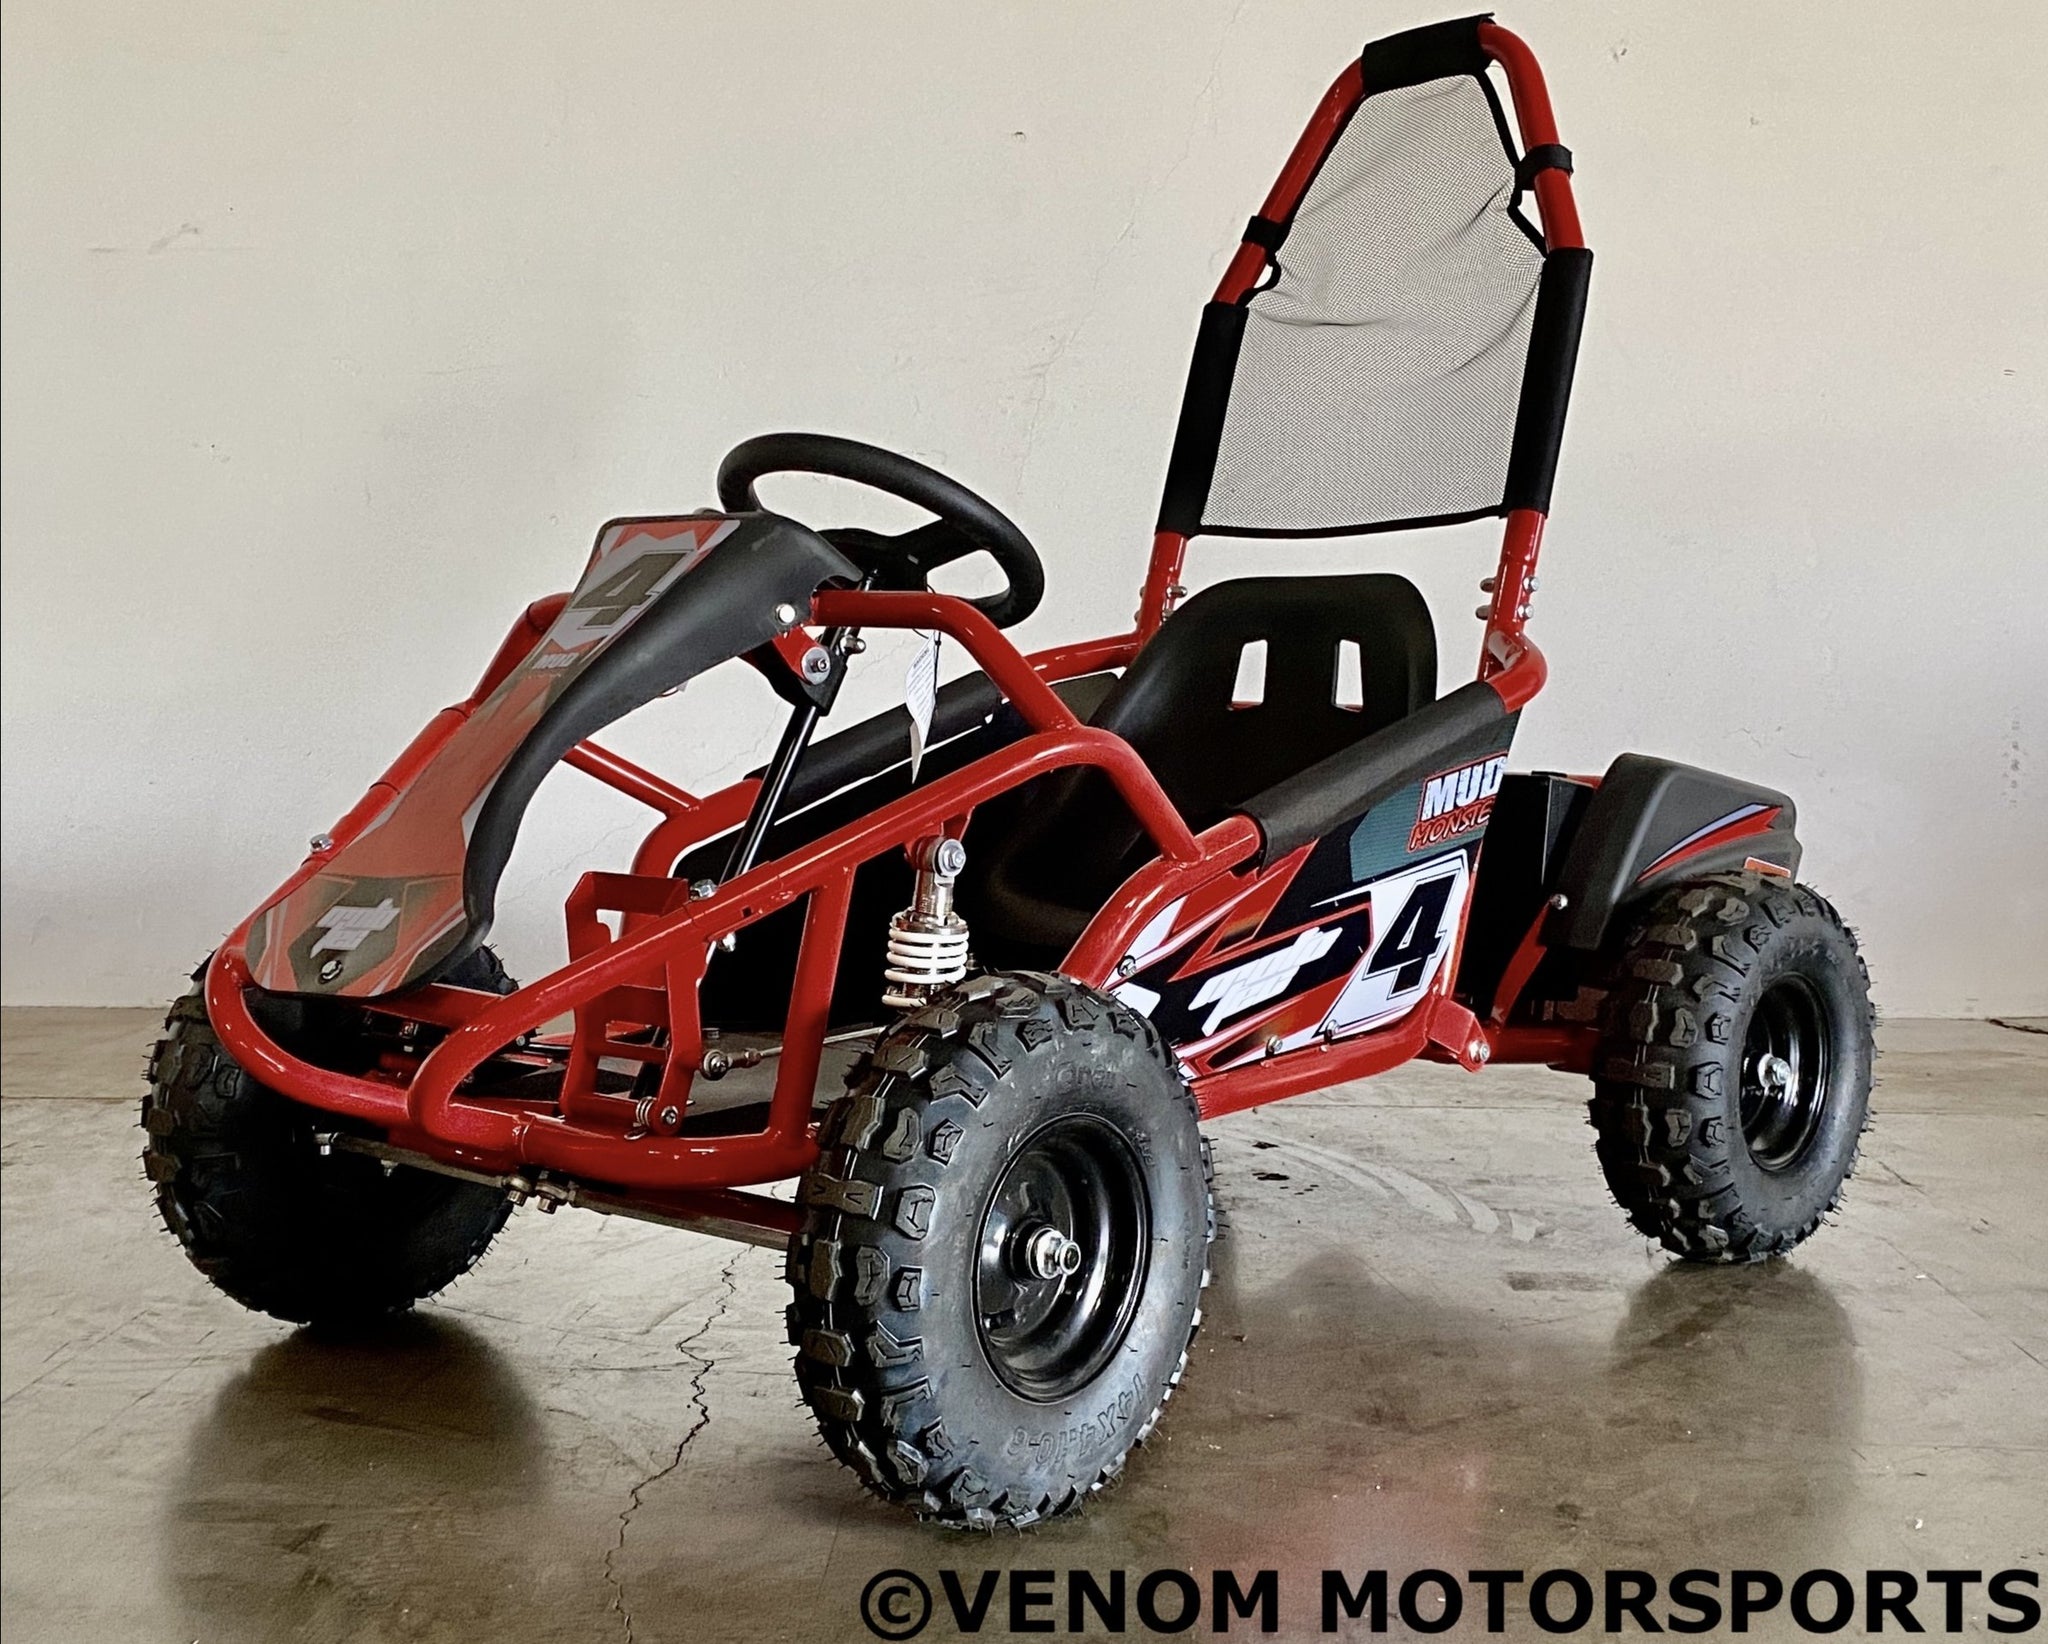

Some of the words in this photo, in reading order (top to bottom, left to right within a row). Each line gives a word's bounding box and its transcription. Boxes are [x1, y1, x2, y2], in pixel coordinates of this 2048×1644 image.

[569, 550, 690, 629] 4
[1421, 755, 1507, 821] MUD
[1409, 800, 1492, 850] MONSTE
[1363, 869, 1459, 999] 4
